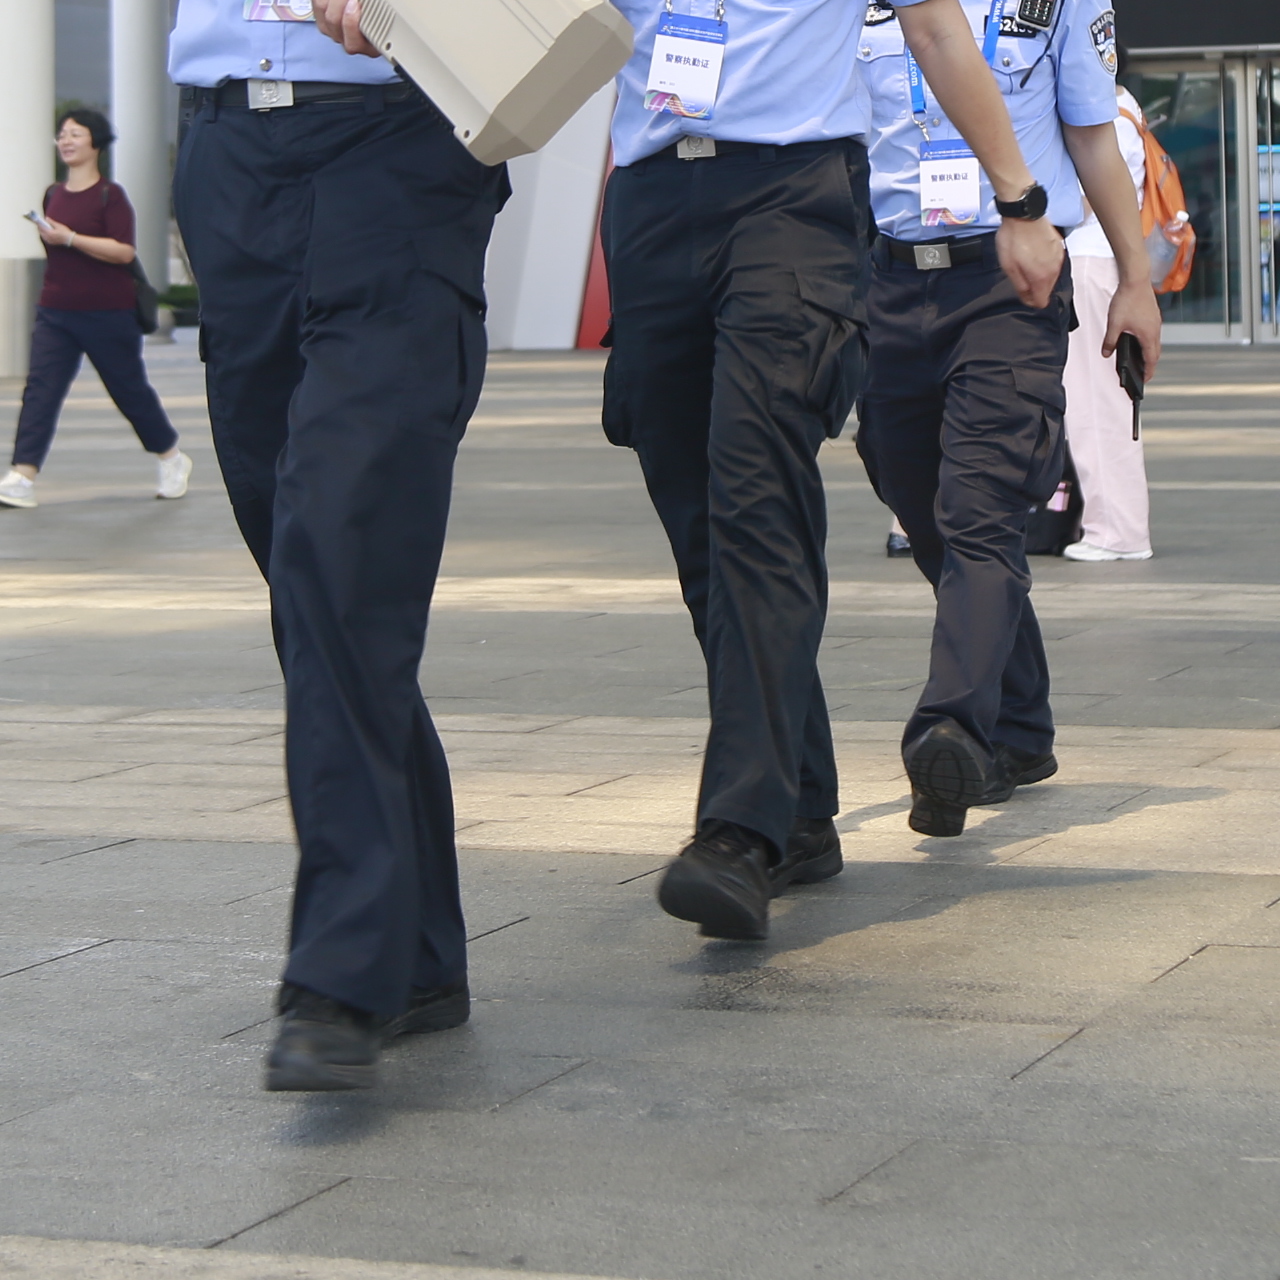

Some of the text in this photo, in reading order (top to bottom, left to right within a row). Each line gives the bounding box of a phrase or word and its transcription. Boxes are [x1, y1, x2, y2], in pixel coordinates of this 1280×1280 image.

[665, 53, 710, 69] 警察执勤证
